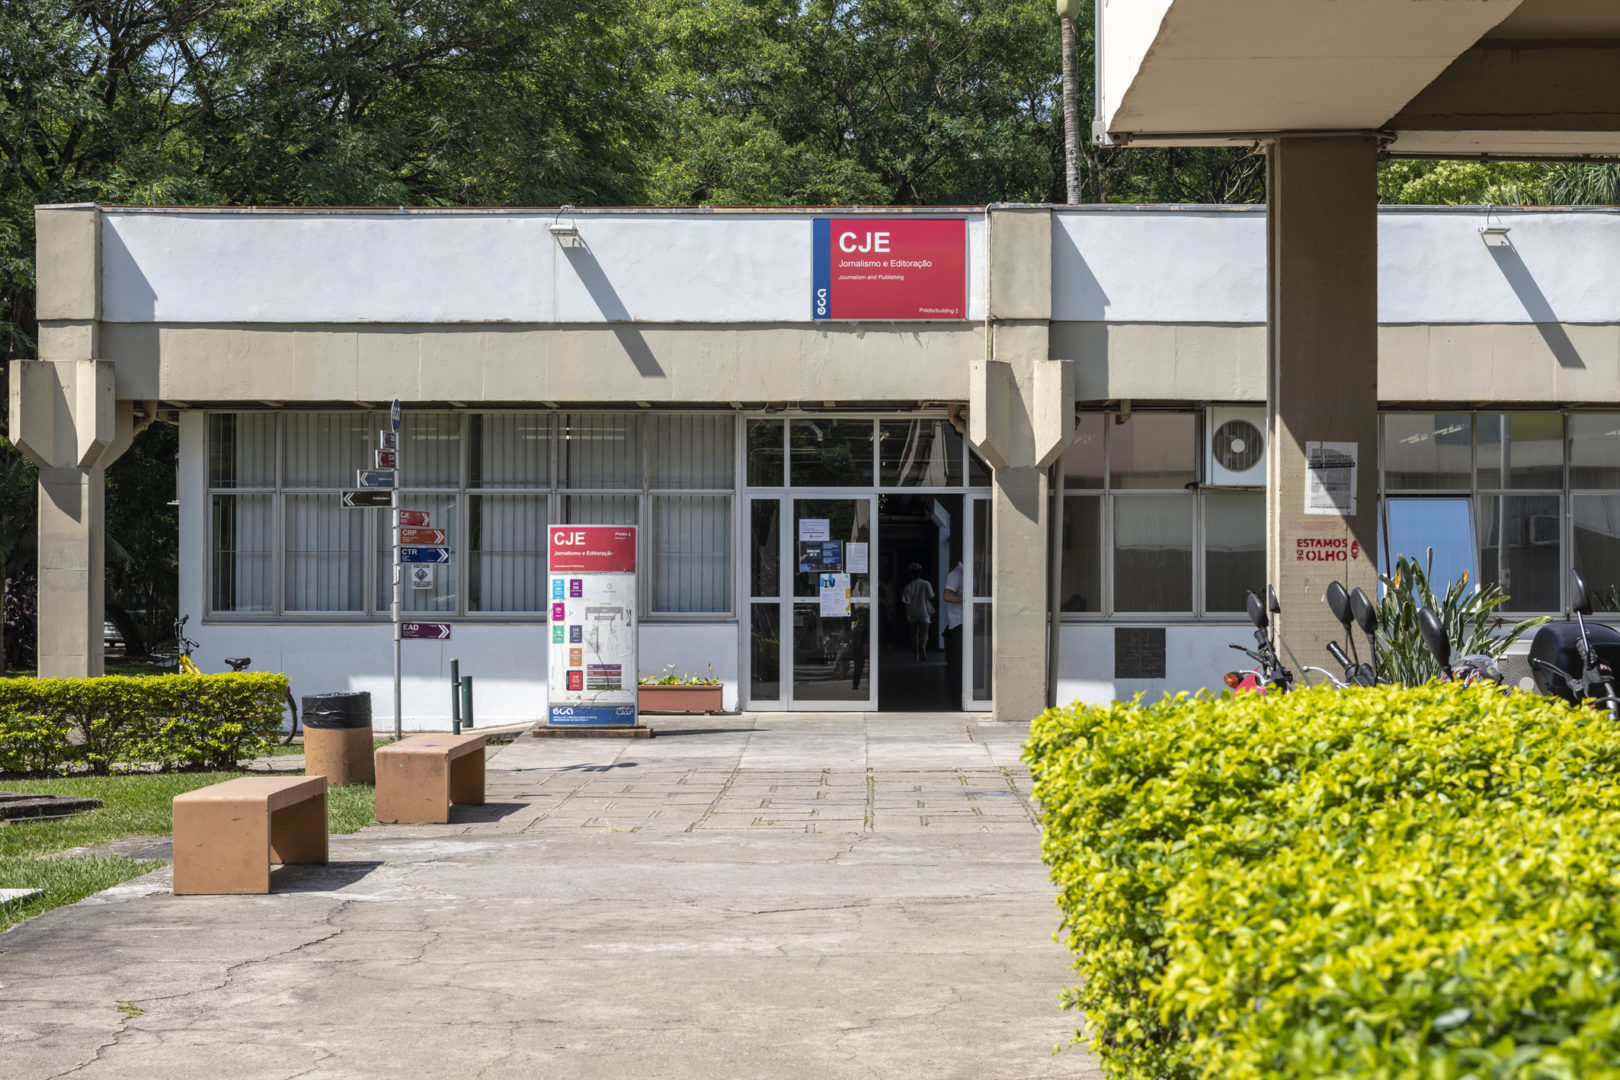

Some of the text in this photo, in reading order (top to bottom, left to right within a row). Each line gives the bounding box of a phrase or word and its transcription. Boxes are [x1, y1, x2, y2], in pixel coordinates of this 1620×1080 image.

[839, 232, 891, 253] CJE
[838, 259, 882, 268] Jornalismo
[890, 259, 933, 269] Editoração
[553, 531, 586, 546] CJE
[1296, 538, 1348, 548] ESTAMOS
[1296, 549, 1348, 562] DE OLHO
[402, 623, 419, 631] EAD
[552, 707, 574, 715] eca
